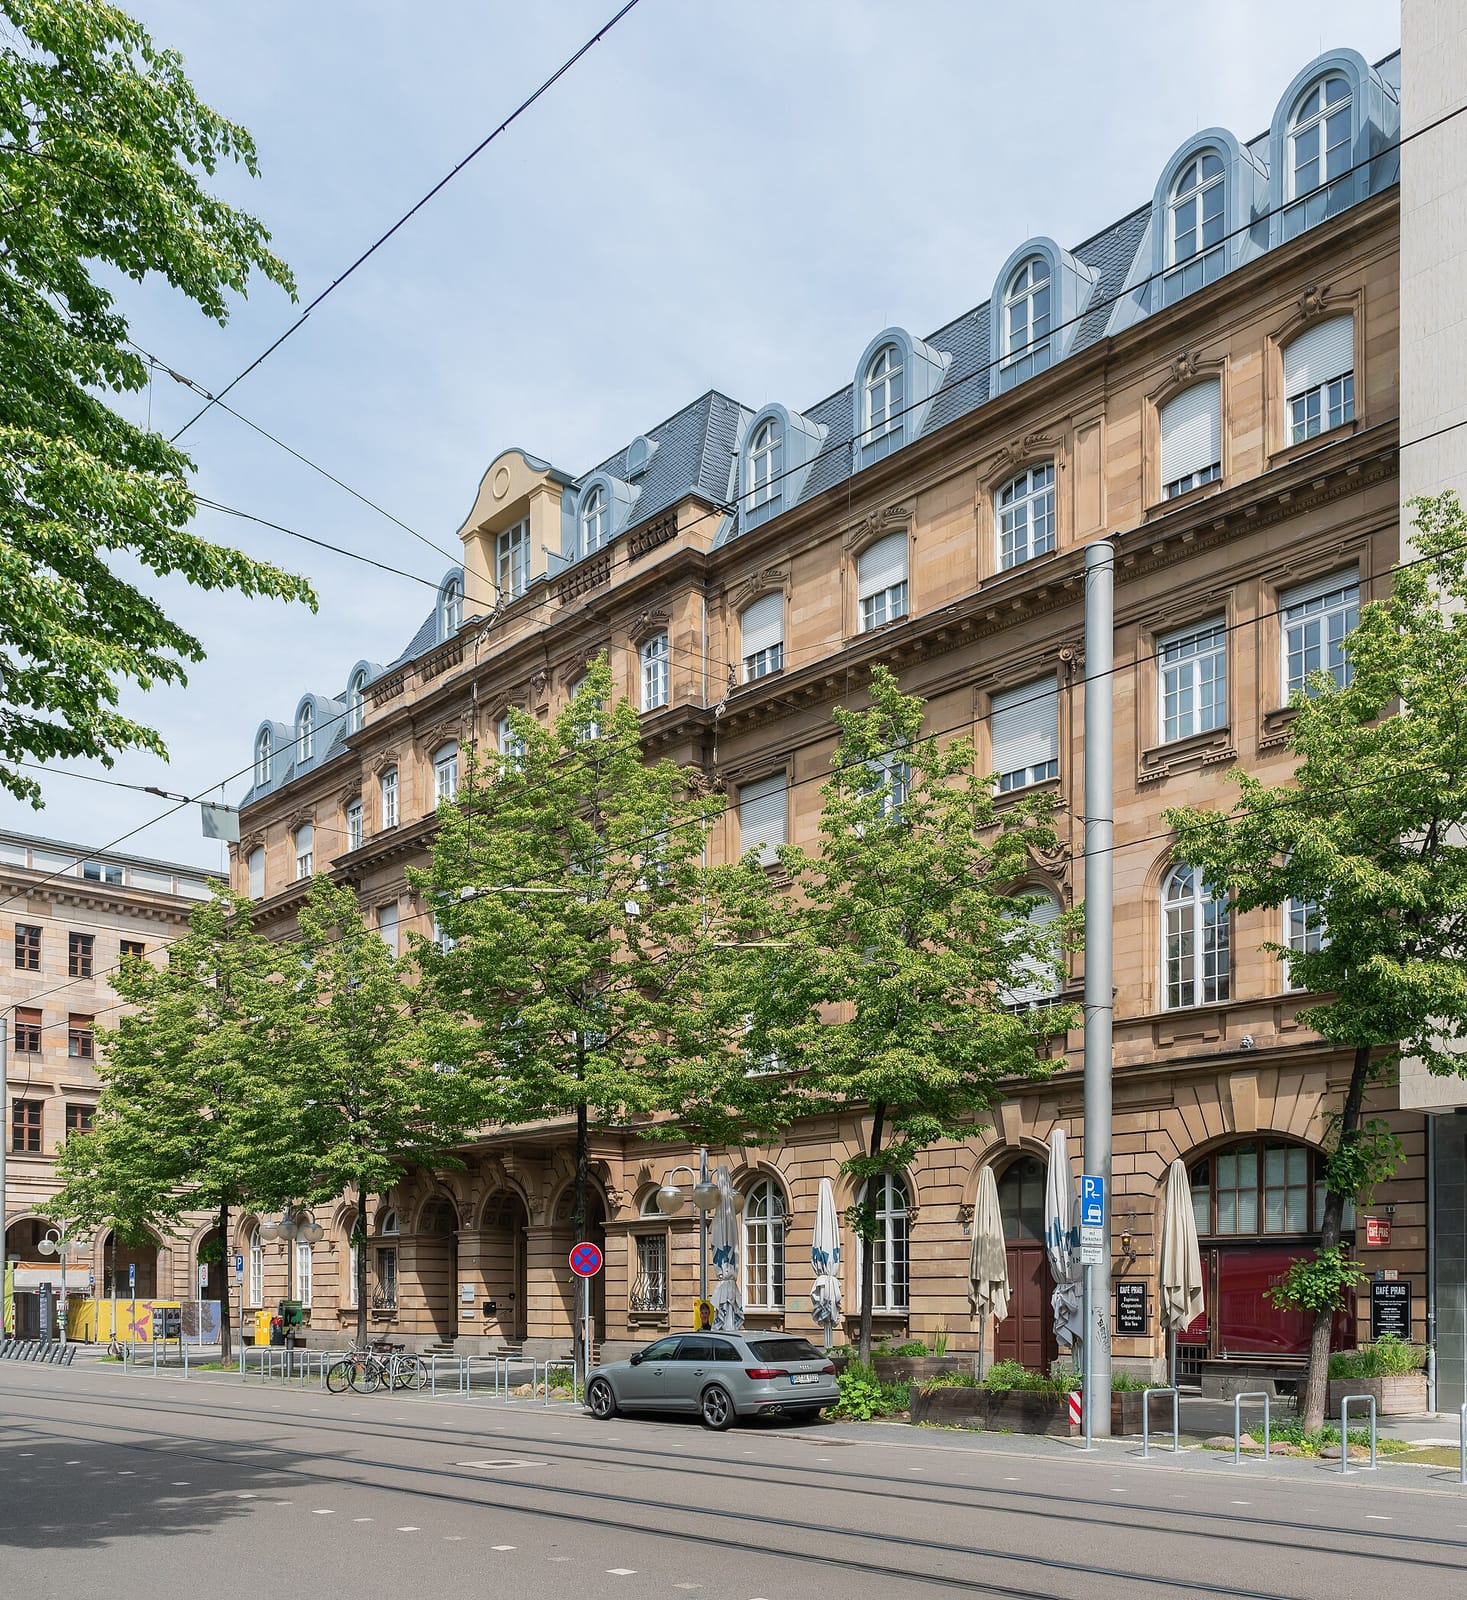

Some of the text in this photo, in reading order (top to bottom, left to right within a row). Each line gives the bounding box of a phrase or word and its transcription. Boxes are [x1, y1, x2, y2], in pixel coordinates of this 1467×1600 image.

[1085, 1179, 1095, 1199] P
[1119, 1285, 1143, 1294] CAFÉ PRAG
[1375, 1285, 1406, 1295] CAFÉ PRAG
